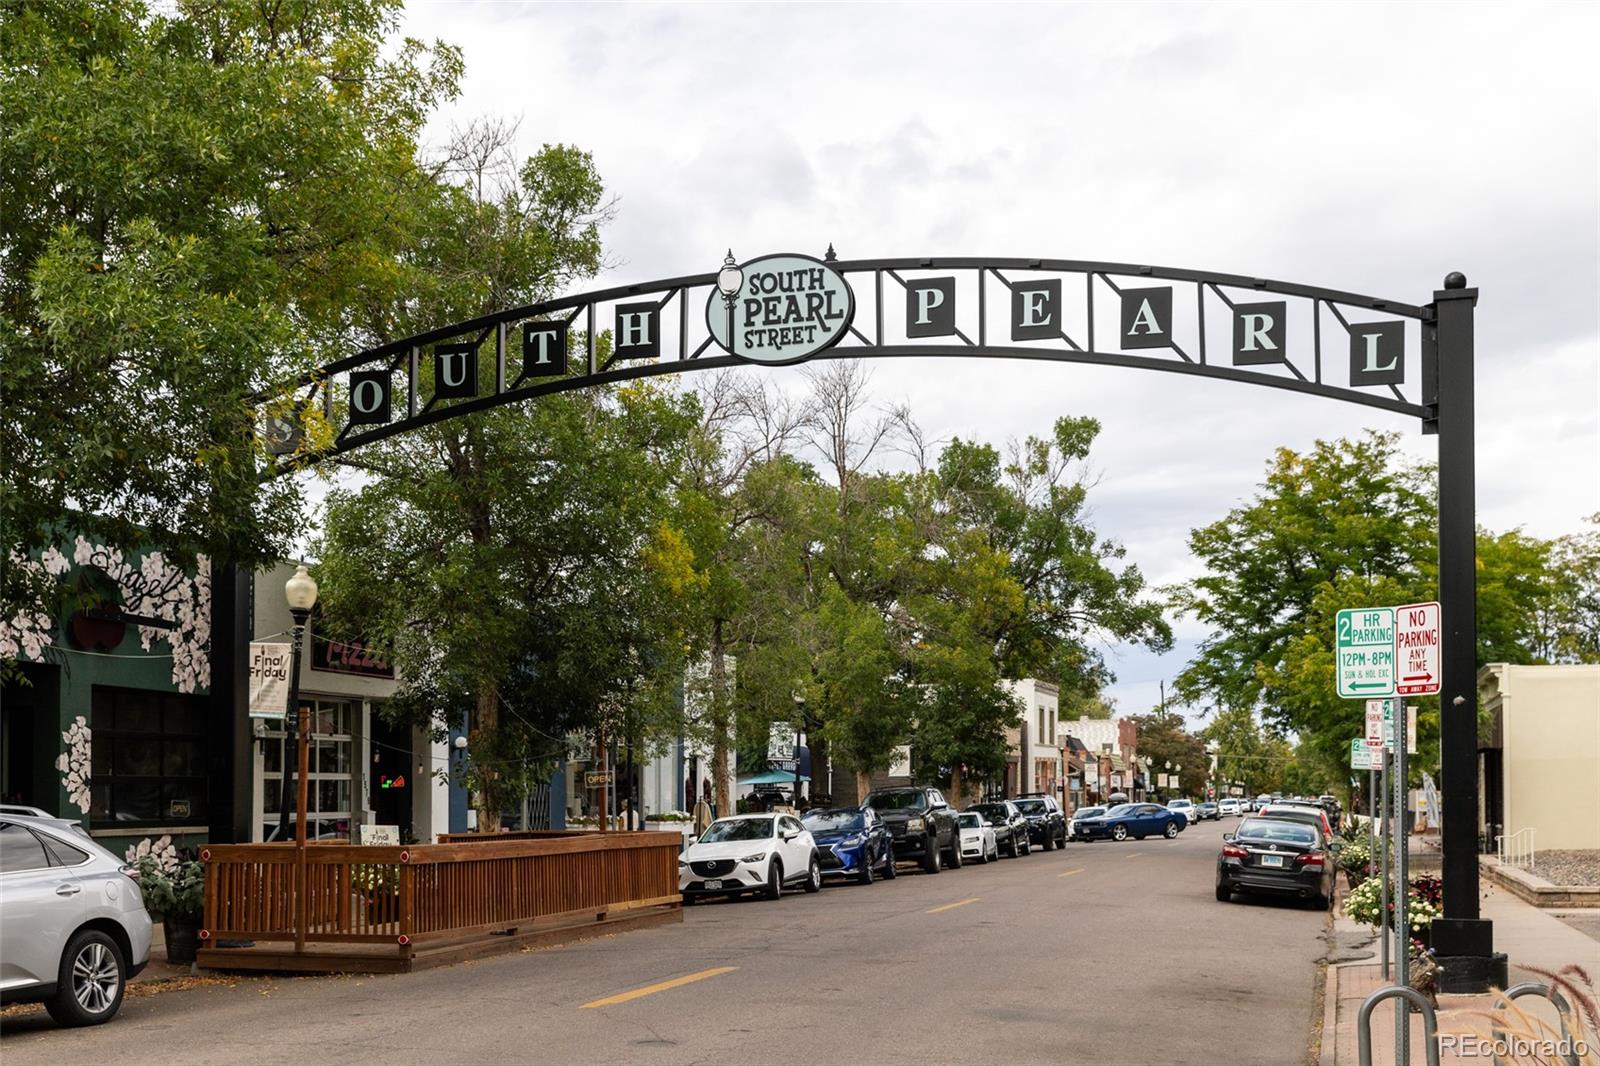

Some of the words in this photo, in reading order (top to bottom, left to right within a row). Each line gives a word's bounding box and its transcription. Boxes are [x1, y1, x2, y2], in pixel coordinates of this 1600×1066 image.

[749, 268, 826, 296] SOUTH
[743, 290, 844, 333] PEARL
[744, 325, 817, 351] STREET
[1339, 618, 1350, 641] 2
[1363, 613, 1380, 627] HR
[1409, 610, 1426, 627] NO
[1352, 628, 1392, 643] PARKING
[1398, 629, 1437, 648] PARKING
[1409, 648, 1427, 660] ANY
[1345, 670, 1356, 679] SUN
[1358, 670, 1364, 678] &
[1366, 669, 1376, 679] HOL
[1378, 669, 1389, 678] EXC
[1408, 660, 1428, 672] TIME
